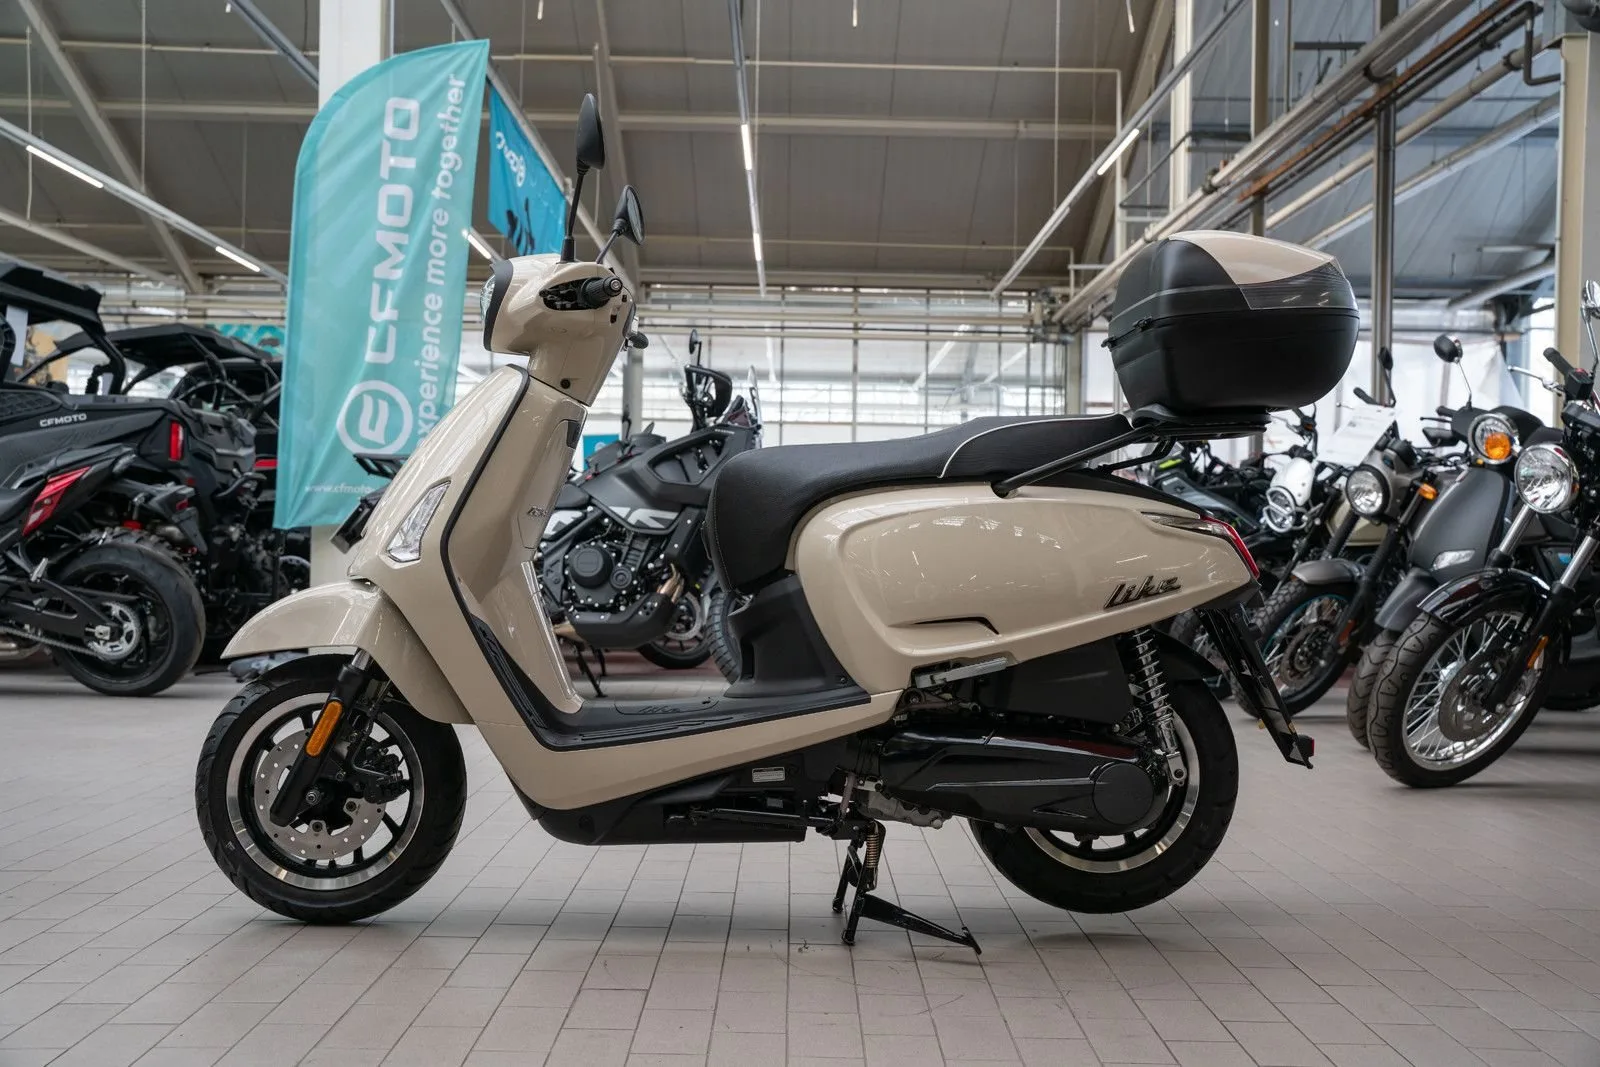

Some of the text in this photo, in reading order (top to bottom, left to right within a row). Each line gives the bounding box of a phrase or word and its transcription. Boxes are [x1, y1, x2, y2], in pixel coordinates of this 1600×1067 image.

[431, 74, 466, 200] together
[364, 97, 421, 365] CFMOTO
[427, 207, 450, 286] more
[39, 412, 88, 428] CFMOTO
